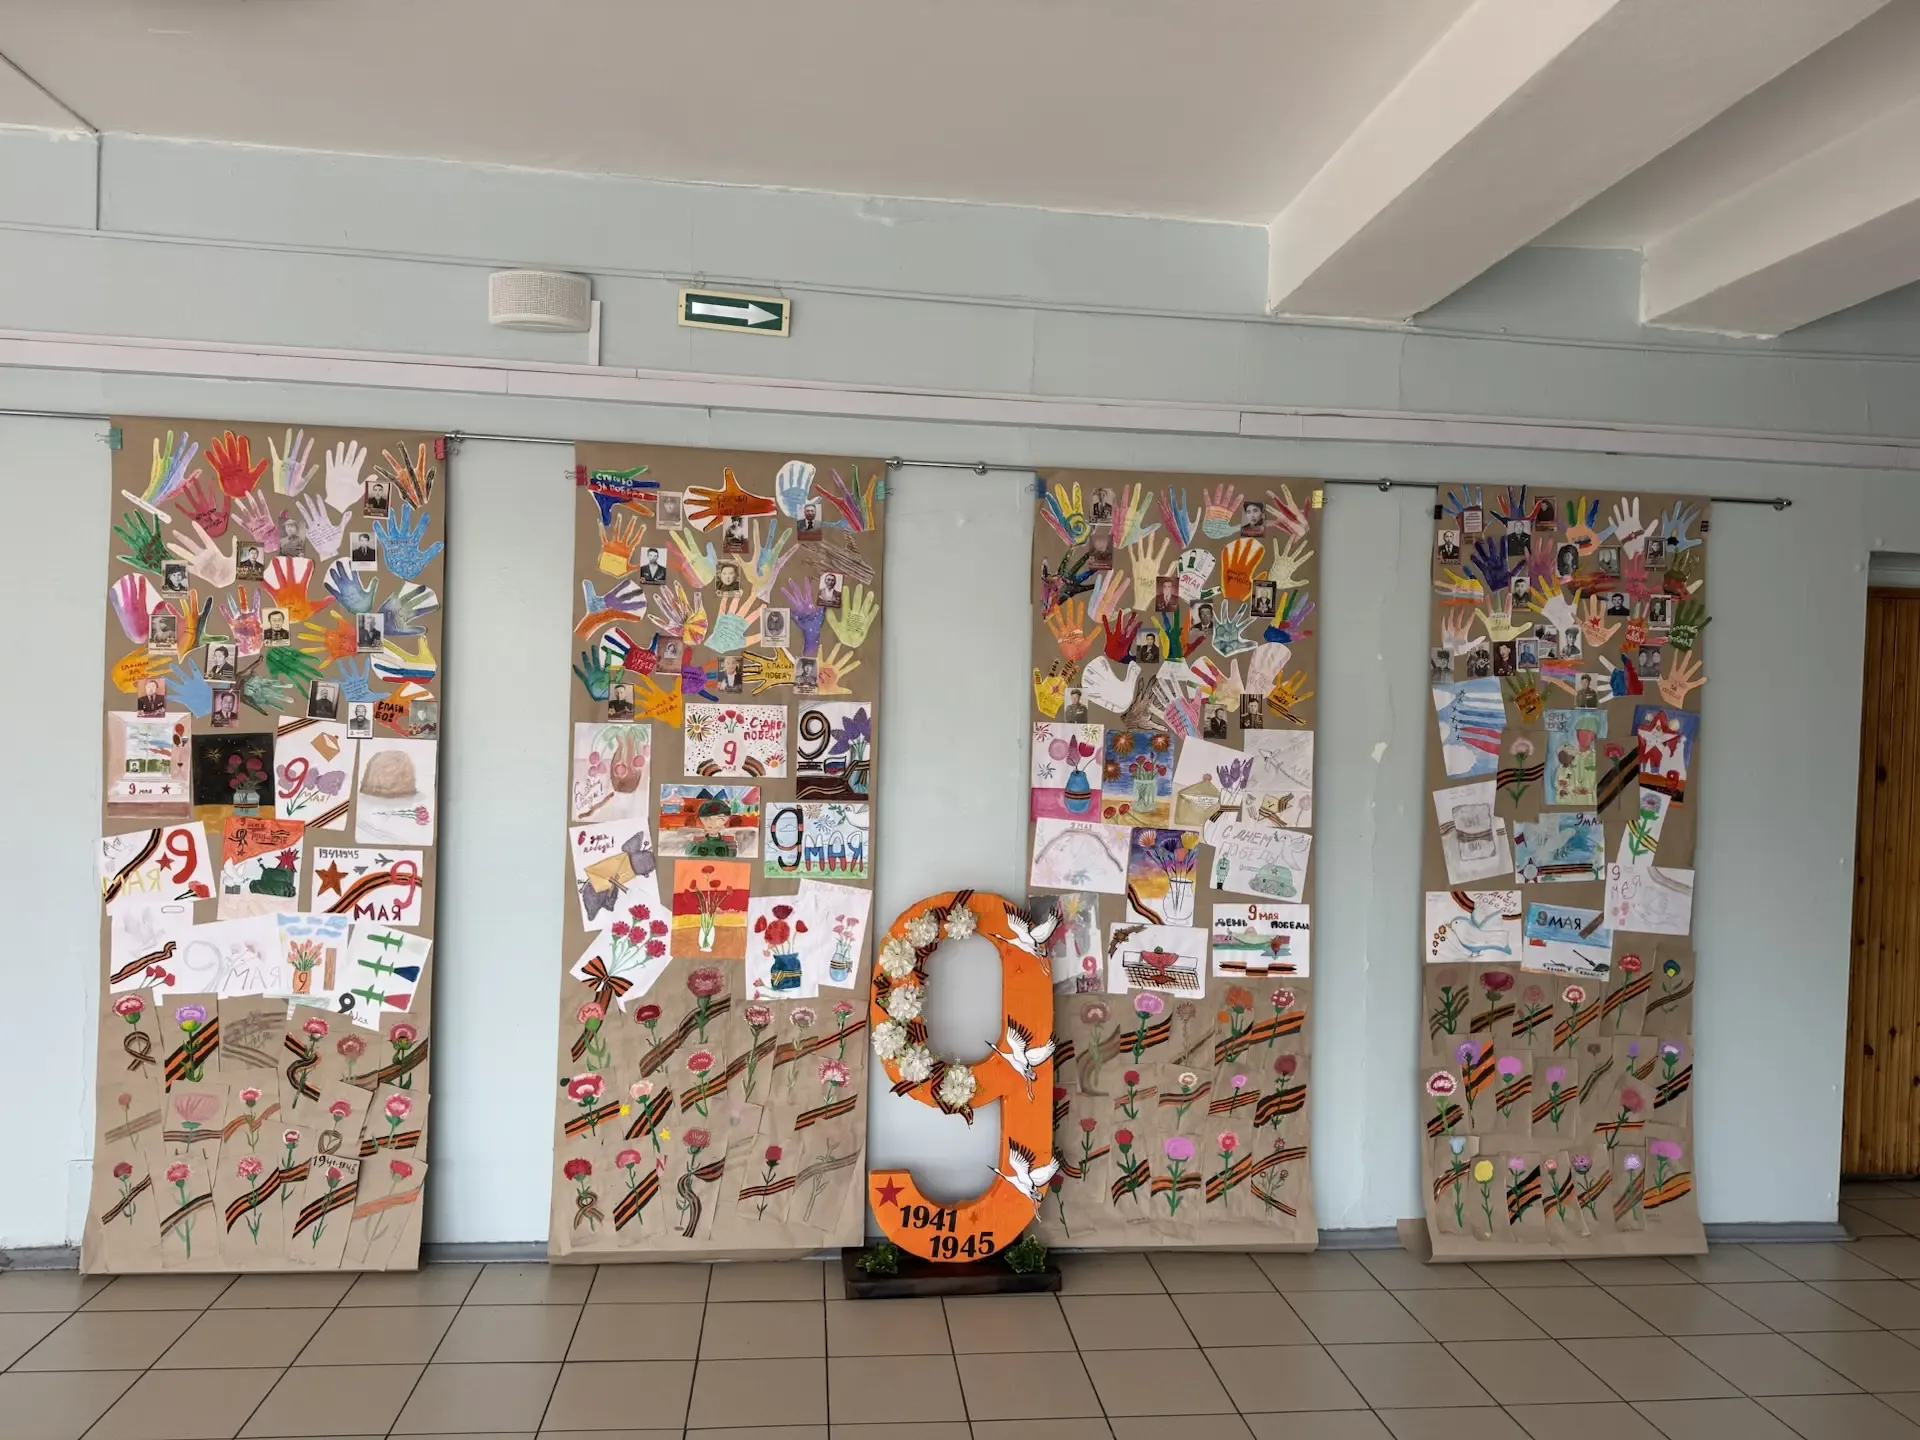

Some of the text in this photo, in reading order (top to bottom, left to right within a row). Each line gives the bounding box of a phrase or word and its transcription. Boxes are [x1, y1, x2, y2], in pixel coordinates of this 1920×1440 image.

[750, 717, 760, 729] С
[797, 710, 830, 759] 9
[723, 740, 738, 765] 9
[278, 757, 309, 799] 9
[128, 783, 136, 795] 9
[1574, 813, 1583, 826] 9
[770, 804, 805, 872] 9
[1222, 825, 1233, 839] С
[166, 829, 197, 884] 9
[1612, 865, 1621, 880] 9
[390, 860, 417, 909] 9
[354, 903, 402, 921] МАЯ
[1248, 905, 1257, 920] 9
[1536, 911, 1582, 931] 9 МАЯ
[1082, 956, 1098, 978] 9
[299, 972, 307, 992] 9
[339, 992, 356, 1013] 9
[900, 1205, 957, 1232] 1941
[929, 1232, 995, 1259] 1945
